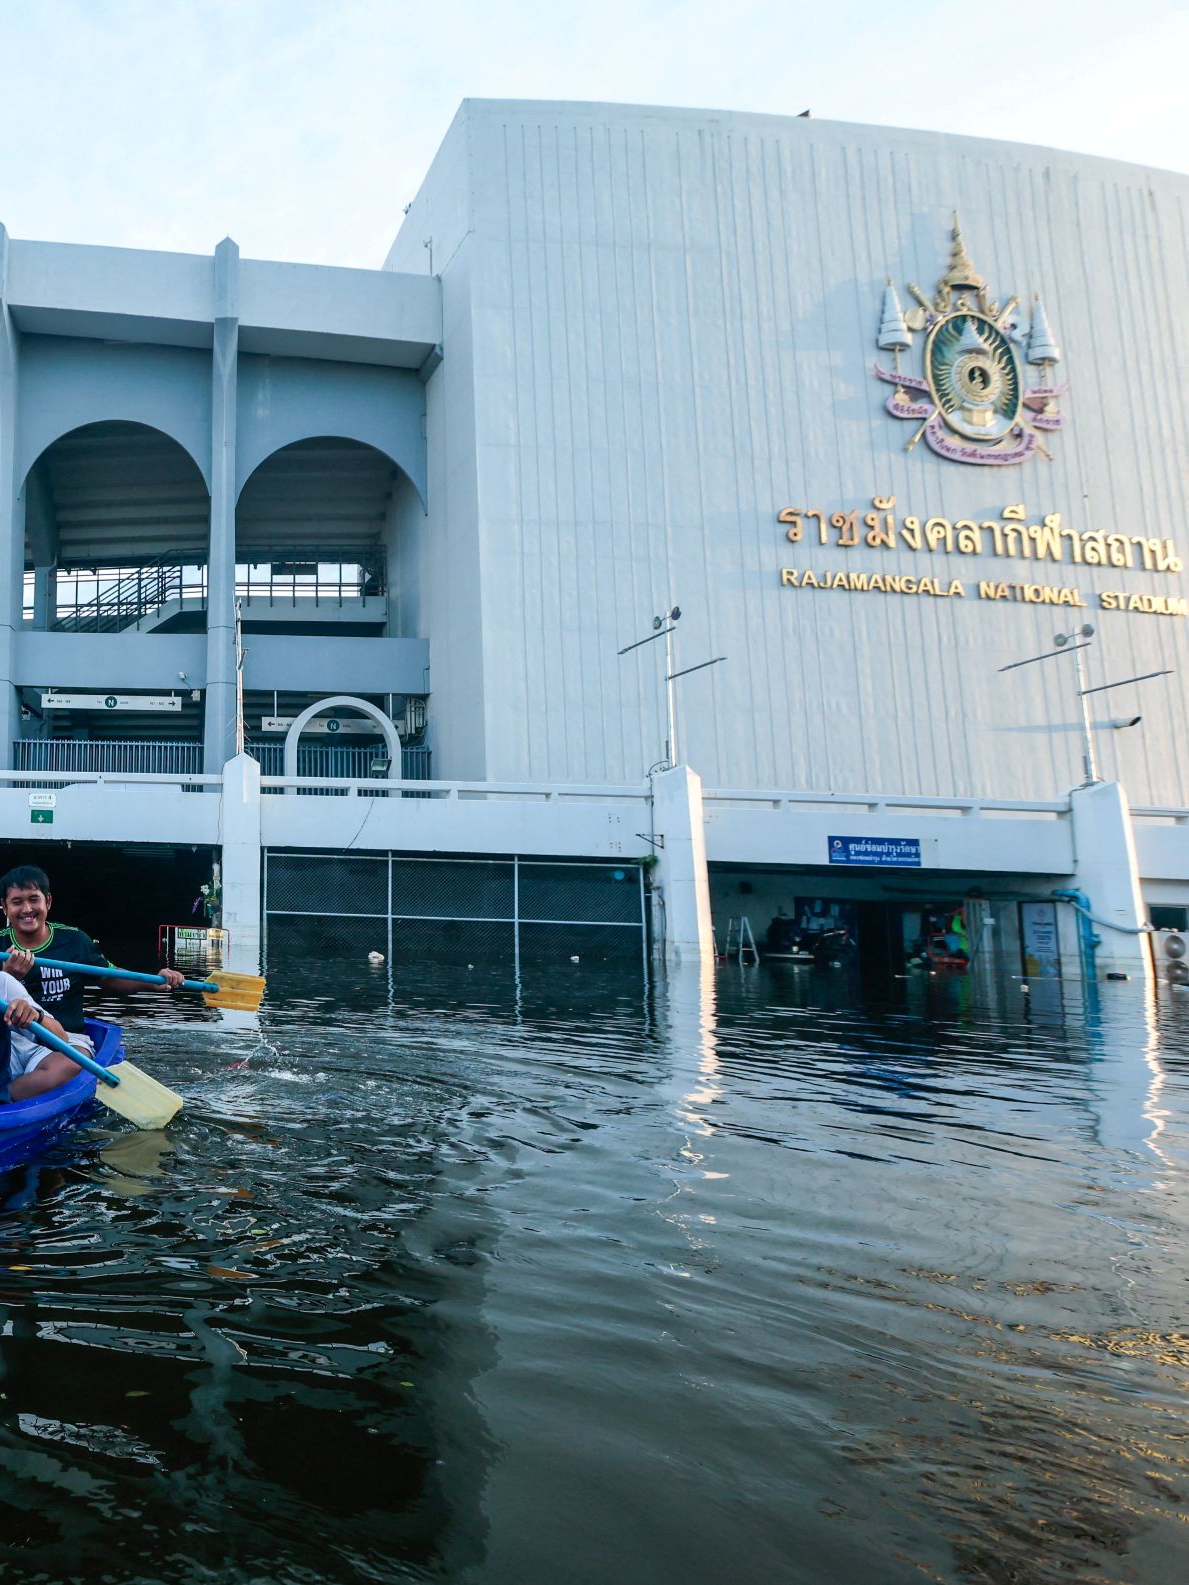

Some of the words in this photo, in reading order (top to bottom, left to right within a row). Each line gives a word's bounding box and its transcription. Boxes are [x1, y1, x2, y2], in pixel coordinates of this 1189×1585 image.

[778, 495, 1184, 572] ราชมังคลากีฬาสถาน
[781, 567, 965, 596] RAJAMANGALA
[979, 581, 1087, 607] NATIONAL
[1100, 591, 1188, 616] STADIUM
[107, 699, 114, 707] N
[330, 722, 337, 730] N
[40, 966, 63, 979] WIN
[41, 977, 71, 995] YOUR
